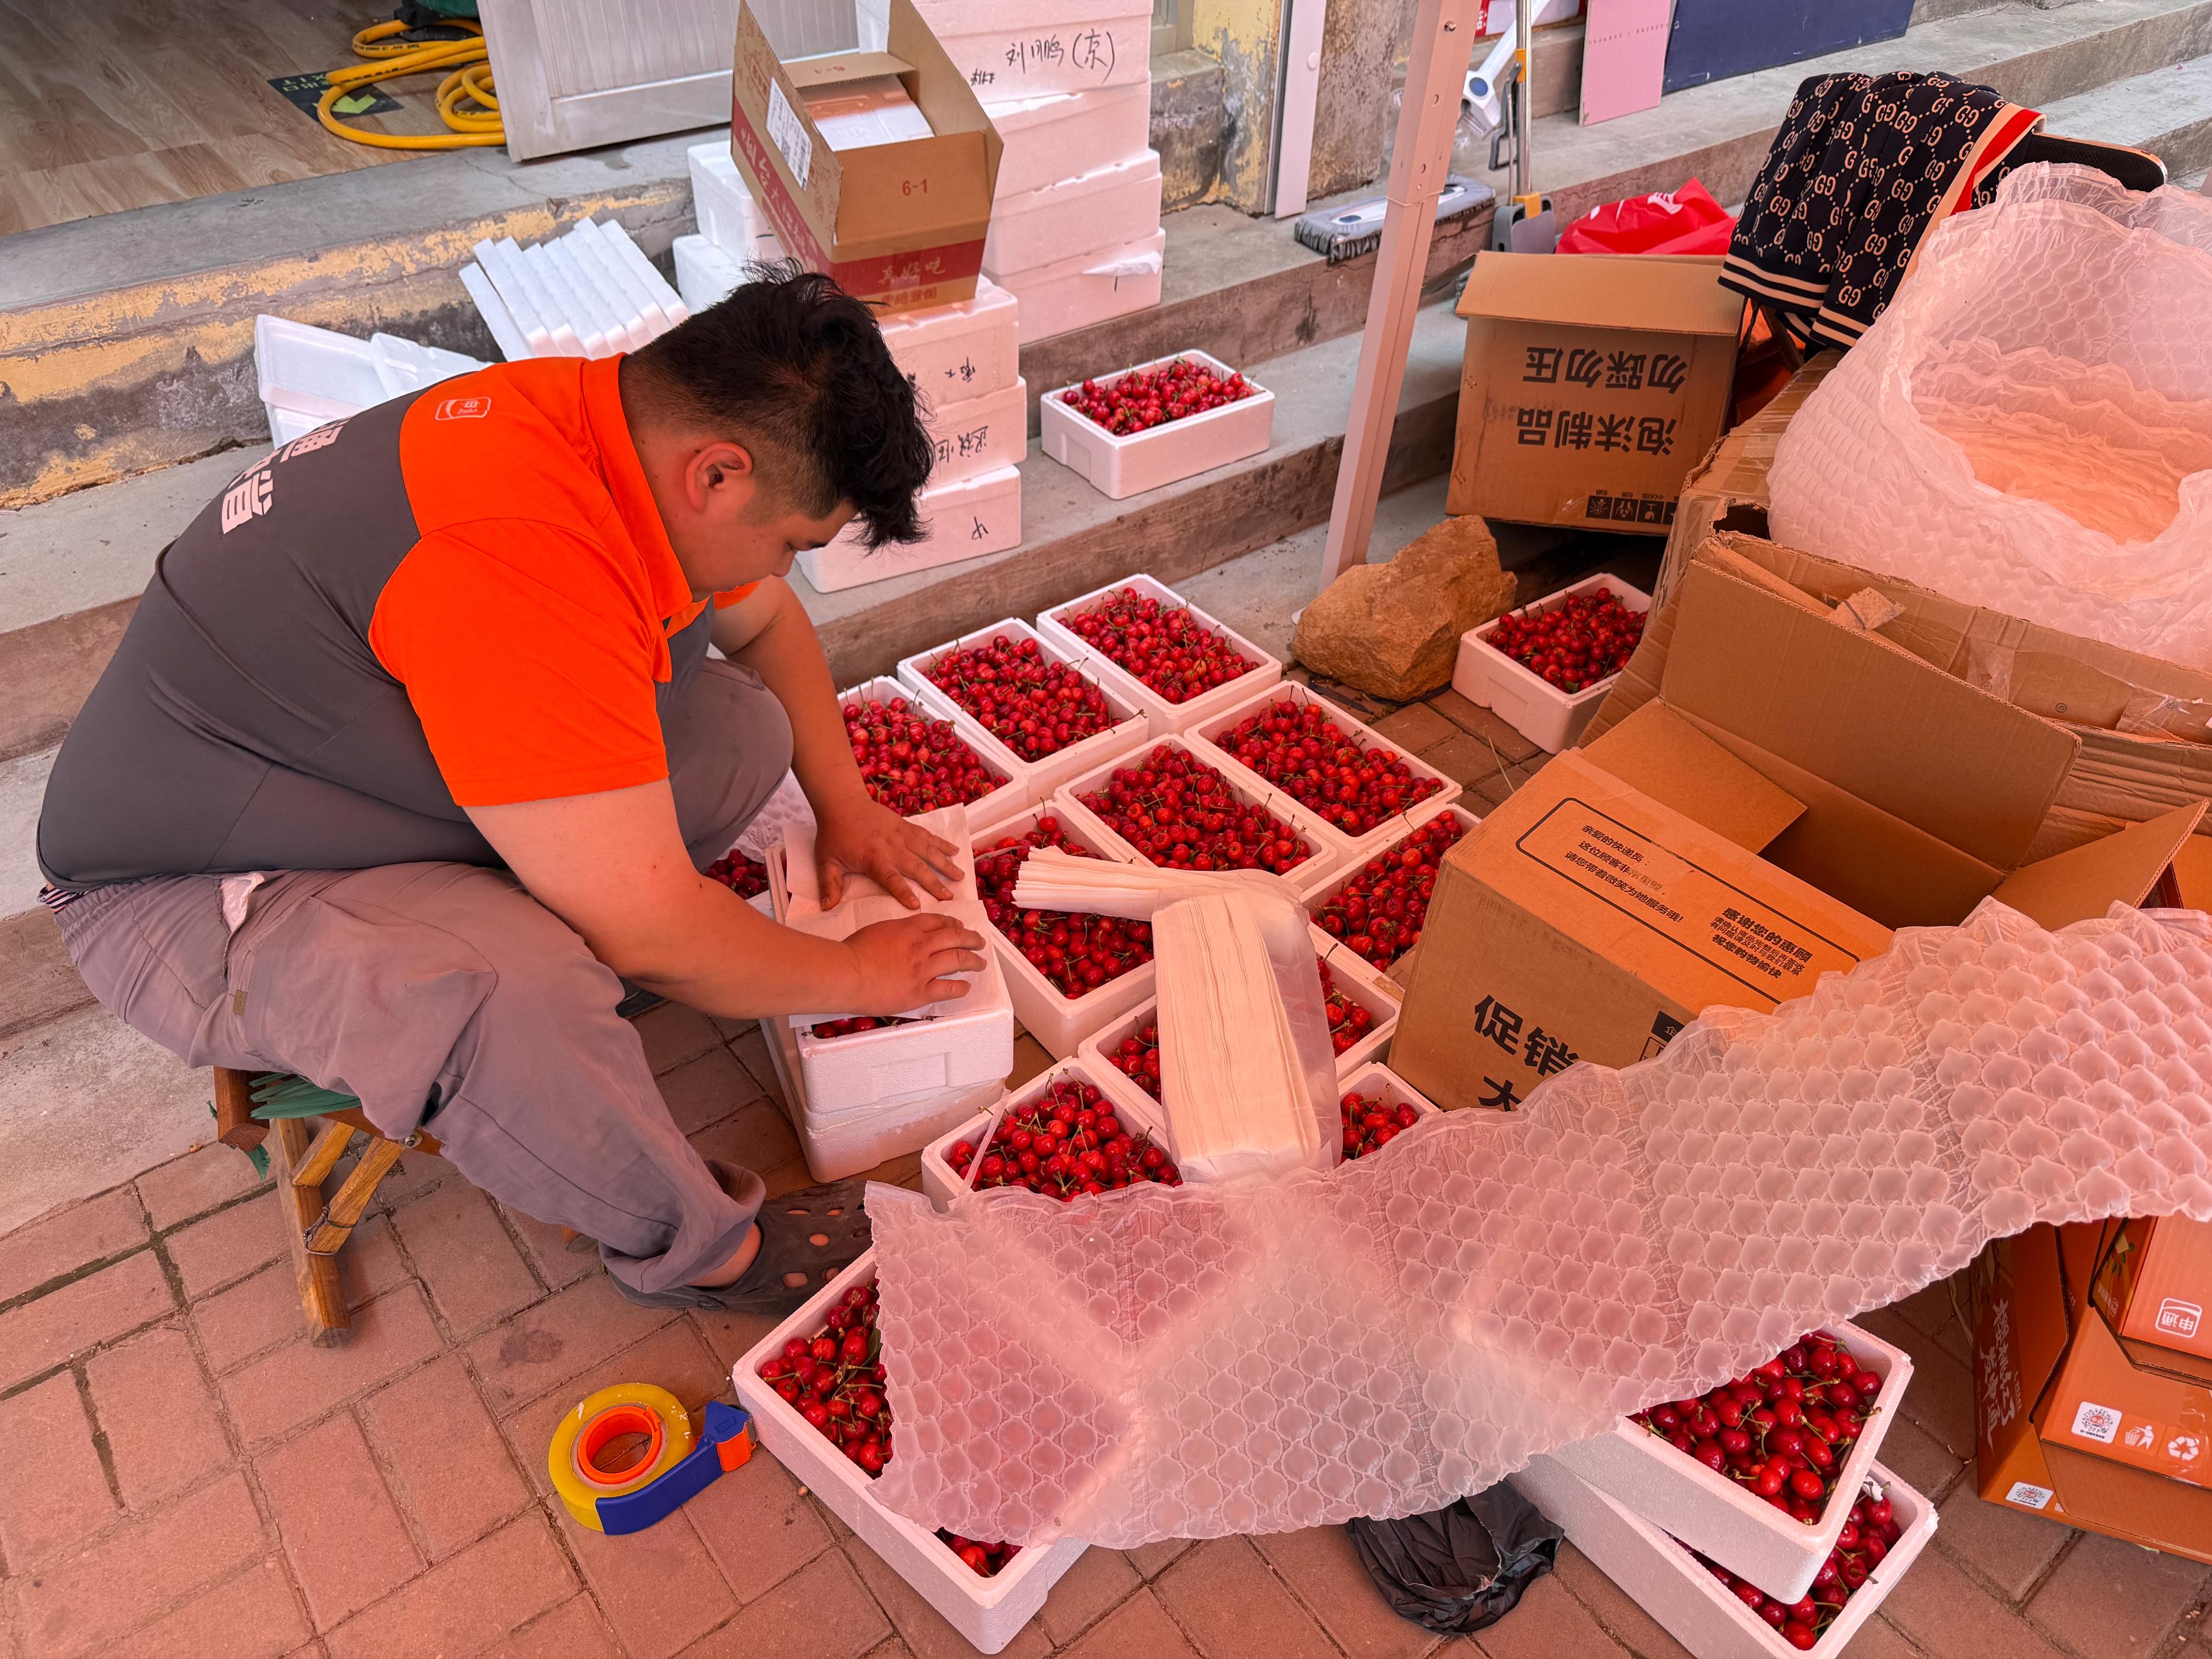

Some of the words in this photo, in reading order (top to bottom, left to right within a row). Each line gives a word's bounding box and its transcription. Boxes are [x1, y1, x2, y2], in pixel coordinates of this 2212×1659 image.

[283, 75, 326, 86] XIT
[283, 81, 324, 92] 出口
[902, 178, 928, 196] 6-1
[879, 257, 946, 285] 真好吃
[1523, 347, 1687, 394] 勿踩勿压
[1517, 408, 1677, 456] 泡沫制品
[1710, 921, 1801, 976] 有问题请及时与我们联系
[1712, 934, 1782, 978] 祝您购物愉快
[1714, 916, 1806, 972] 请确认商品完整后再签收
[1722, 908, 1813, 963] 感谢您的惠顾
[1474, 995, 1579, 1076] 促销
[2161, 1311, 2195, 1331] 申通
[1993, 1297, 2014, 1426] 樱桃红了
[1980, 1340, 2000, 1458] 发申通
